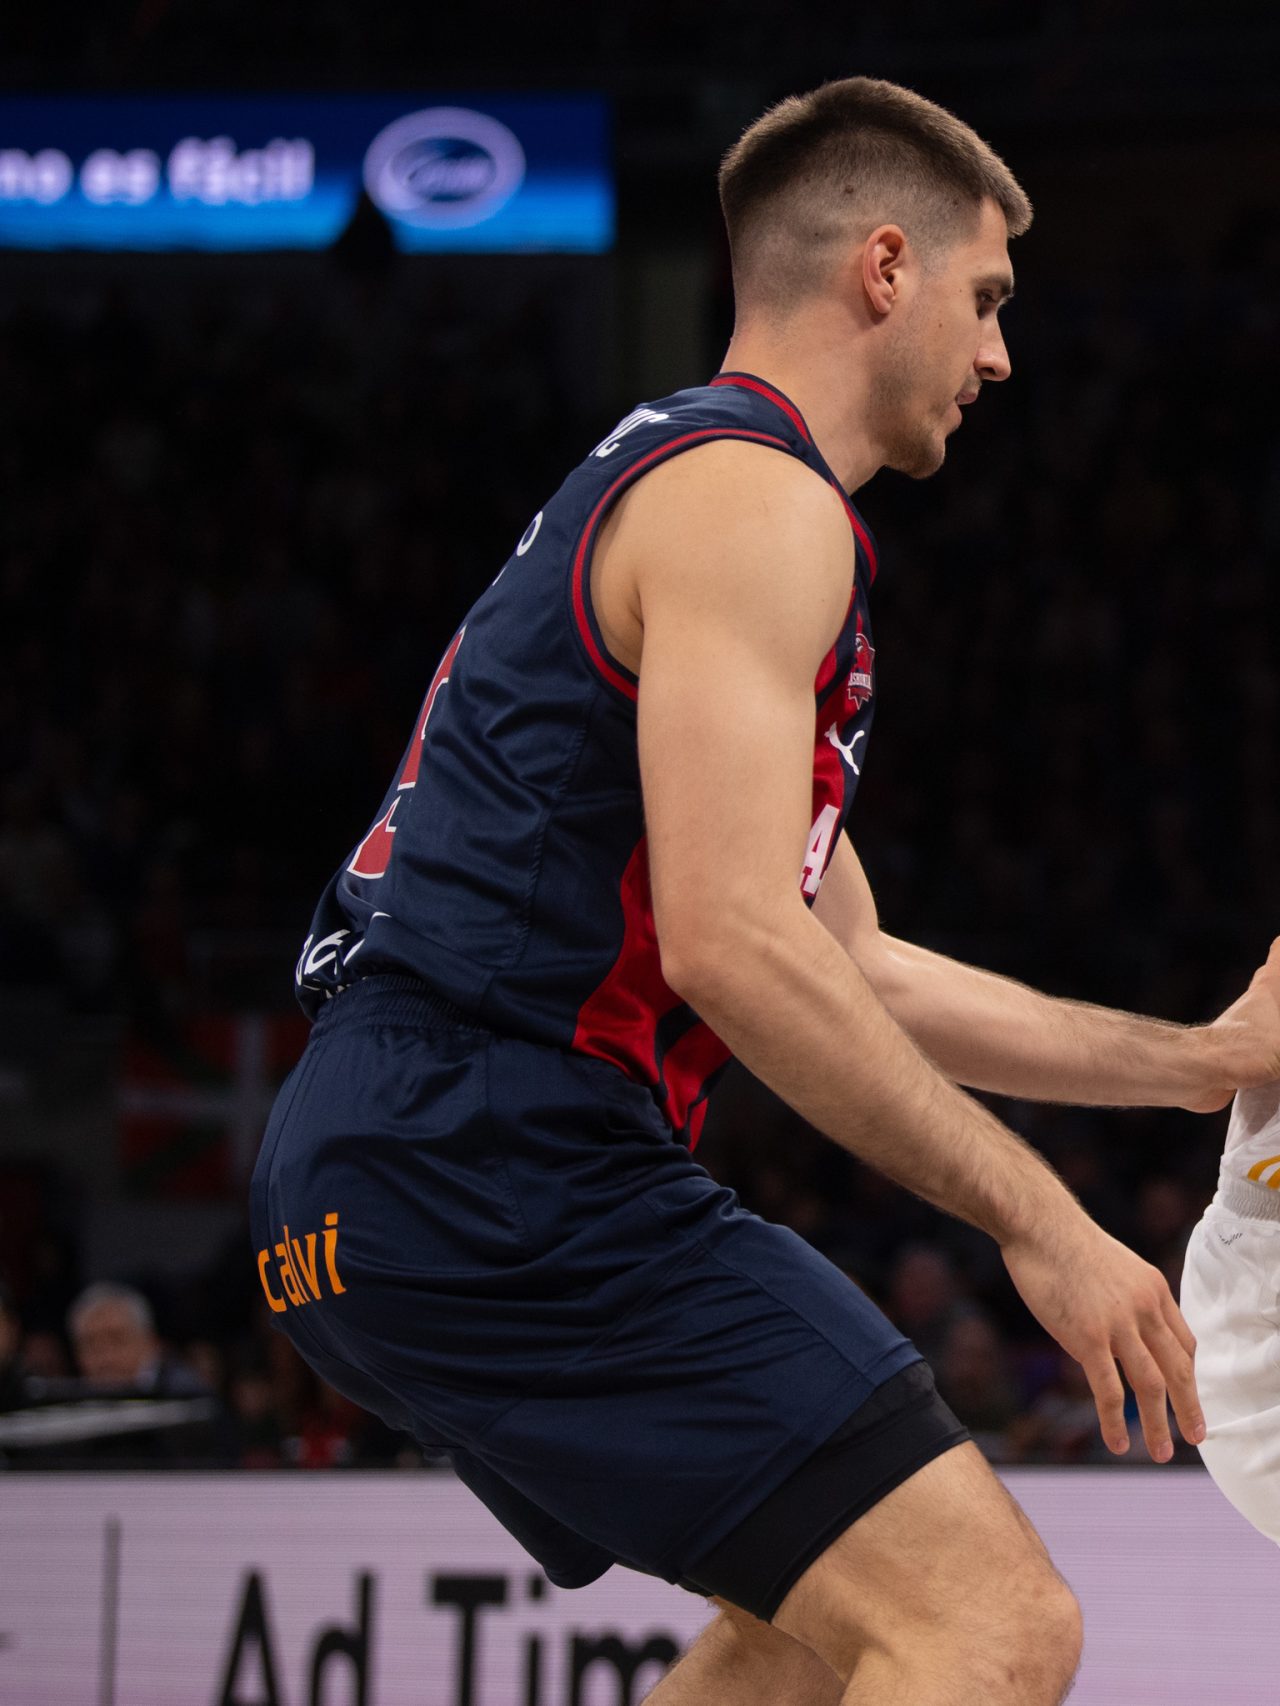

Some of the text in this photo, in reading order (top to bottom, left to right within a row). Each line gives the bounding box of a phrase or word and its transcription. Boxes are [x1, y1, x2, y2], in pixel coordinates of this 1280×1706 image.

[79, 148, 161, 205] es
[257, 1211, 347, 1313] calvi
[213, 1566, 378, 1706] Ad
